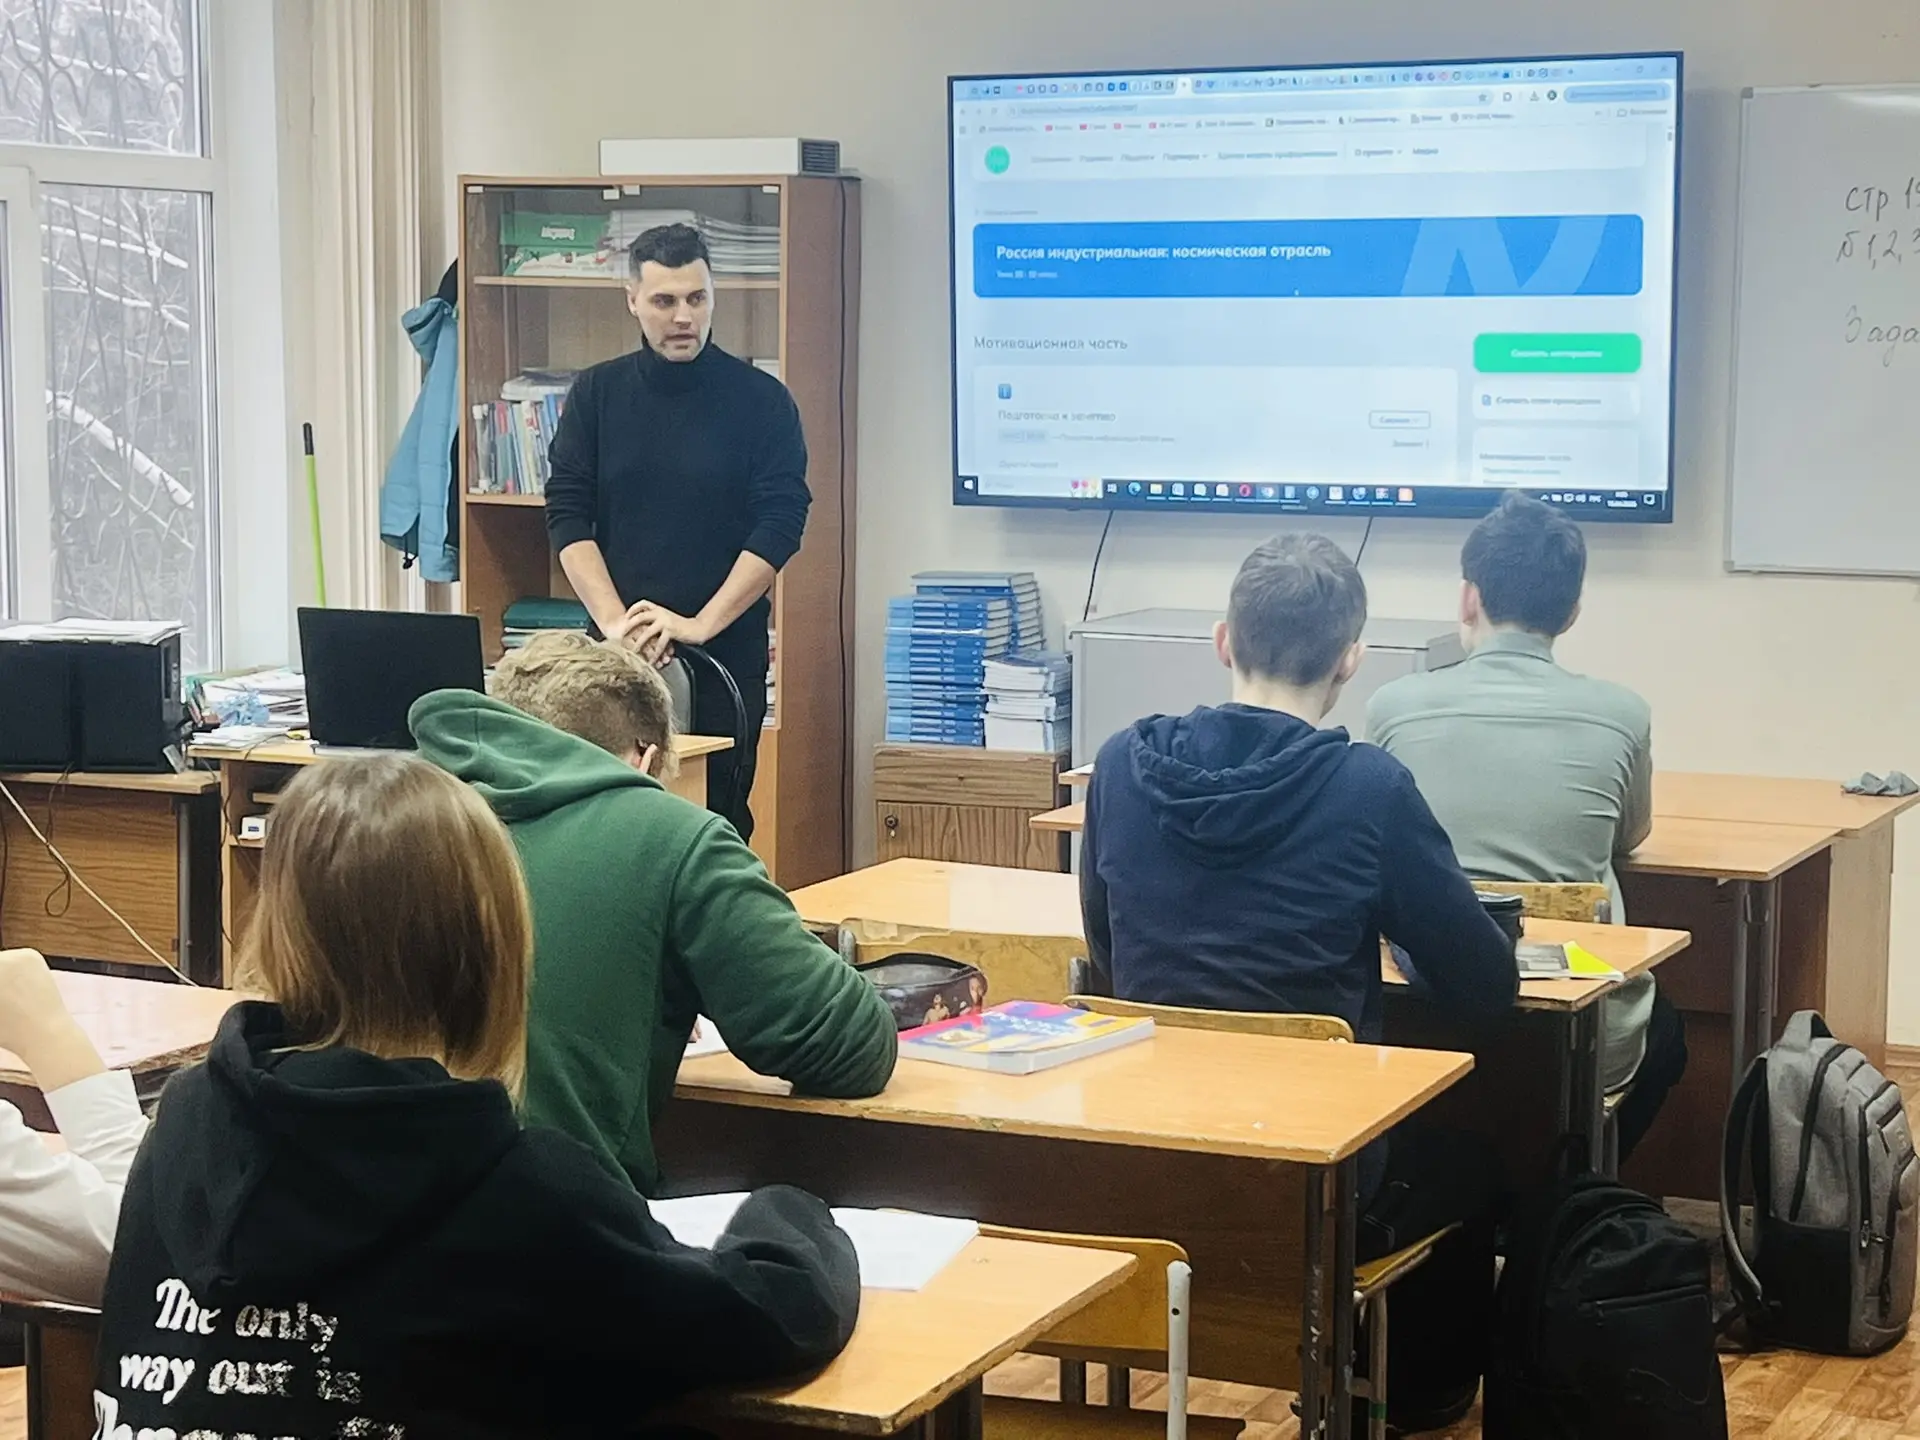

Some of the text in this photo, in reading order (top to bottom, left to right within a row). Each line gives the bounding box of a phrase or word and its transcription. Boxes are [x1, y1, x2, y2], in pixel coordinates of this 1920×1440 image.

[996, 244, 1331, 263] Россия индустриальная: космическая отрасль
[974, 337, 1128, 350] Мотивационная часть
[155, 1278, 338, 1353] The only
[119, 1353, 196, 1405] way
